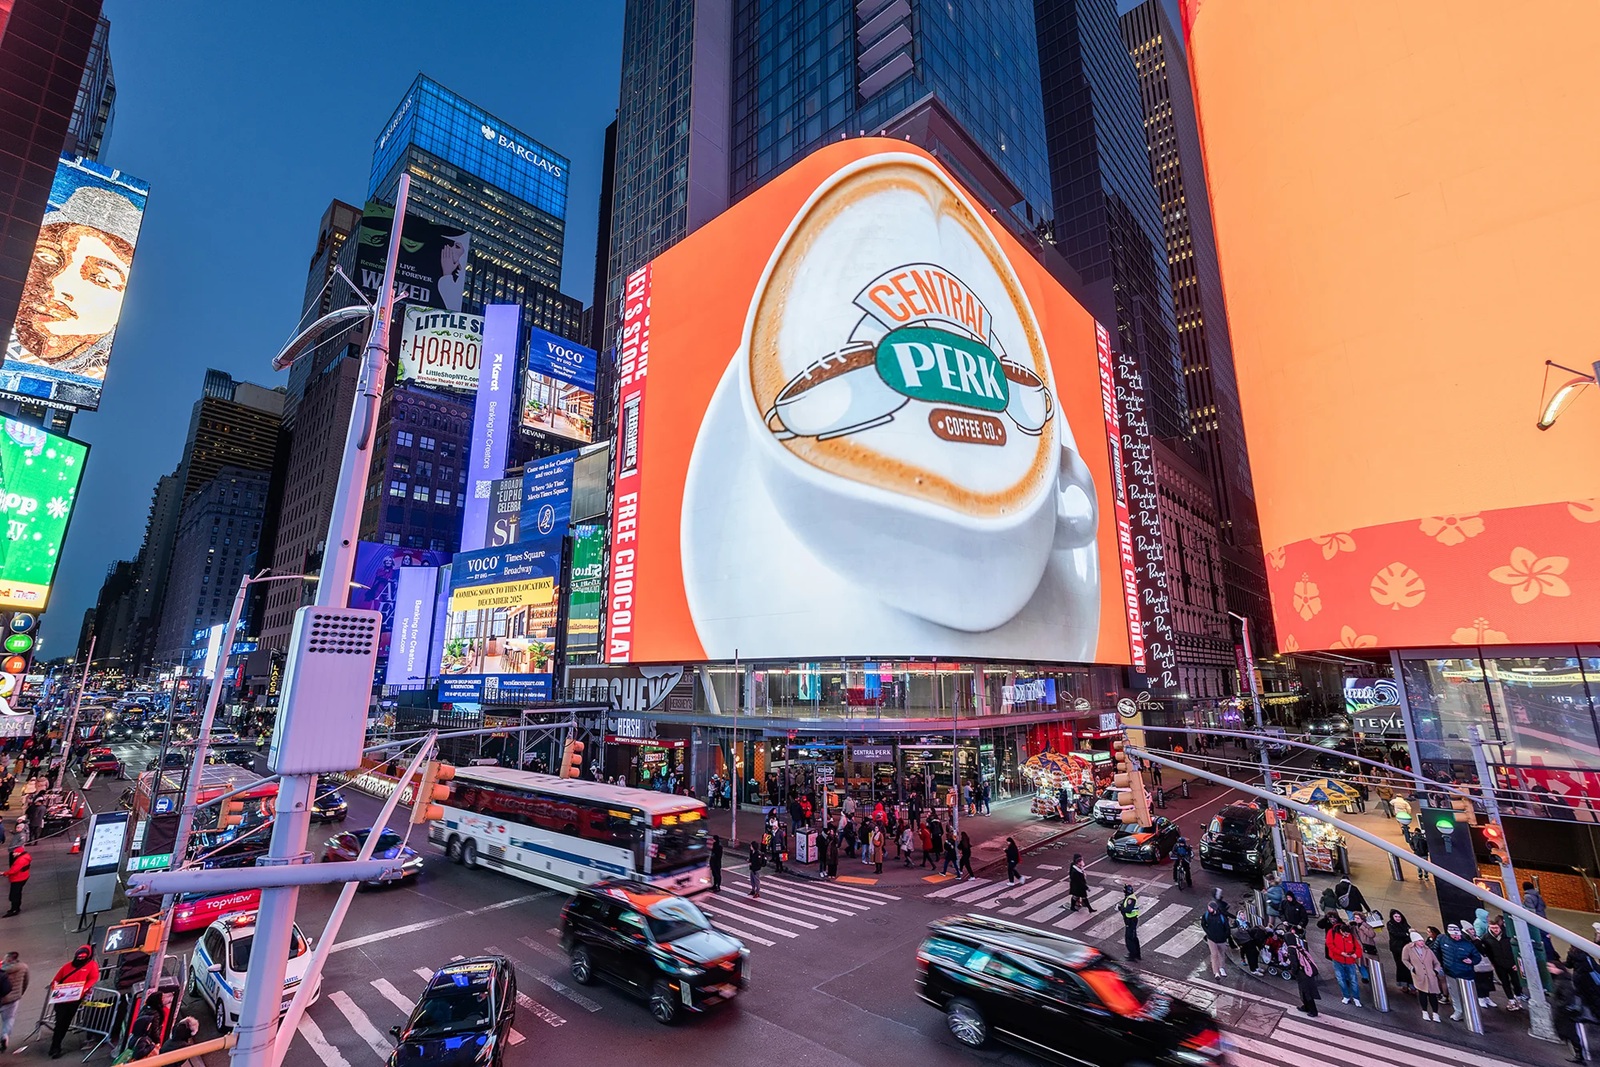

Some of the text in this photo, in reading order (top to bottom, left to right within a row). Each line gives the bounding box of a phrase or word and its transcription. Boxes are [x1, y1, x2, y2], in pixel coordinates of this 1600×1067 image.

[498, 134, 562, 178] BARCLAYS
[360, 259, 385, 270] Remem
[401, 270, 433, 283] FOREVER.
[400, 263, 416, 271] LIVE.
[361, 268, 431, 302] WCKED
[868, 270, 987, 341] CENTRAL
[415, 314, 467, 331] LITTLE
[411, 334, 483, 374] HORRO
[620, 320, 643, 388] STORE
[490, 363, 503, 391] Karat
[891, 342, 1006, 401] PERK
[1099, 367, 1113, 425] STORE
[483, 401, 497, 469] Banking for Creators
[522, 428, 546, 440] KEVANI
[945, 415, 999, 440] COFFEE CO.
[1122, 435, 1151, 449] Paradise
[556, 457, 574, 466] Comfort
[540, 490, 553, 498] Times
[552, 487, 569, 496] Square
[617, 491, 638, 545] FREE
[505, 550, 545, 562] Times Square
[1119, 521, 1134, 568] FREE
[504, 565, 532, 575] Broadway
[455, 589, 478, 598] COMING
[479, 587, 495, 596] SOON
[504, 584, 518, 593] THIS
[518, 580, 551, 592] LOCATION
[478, 597, 510, 606] DECEMBER
[610, 548, 635, 663] CHOCOLAT
[1124, 568, 1146, 665] CHOCOLAT
[407, 600, 422, 672] Banking for Creators
[141, 858, 150, 868] W
[150, 856, 161, 867] 47
